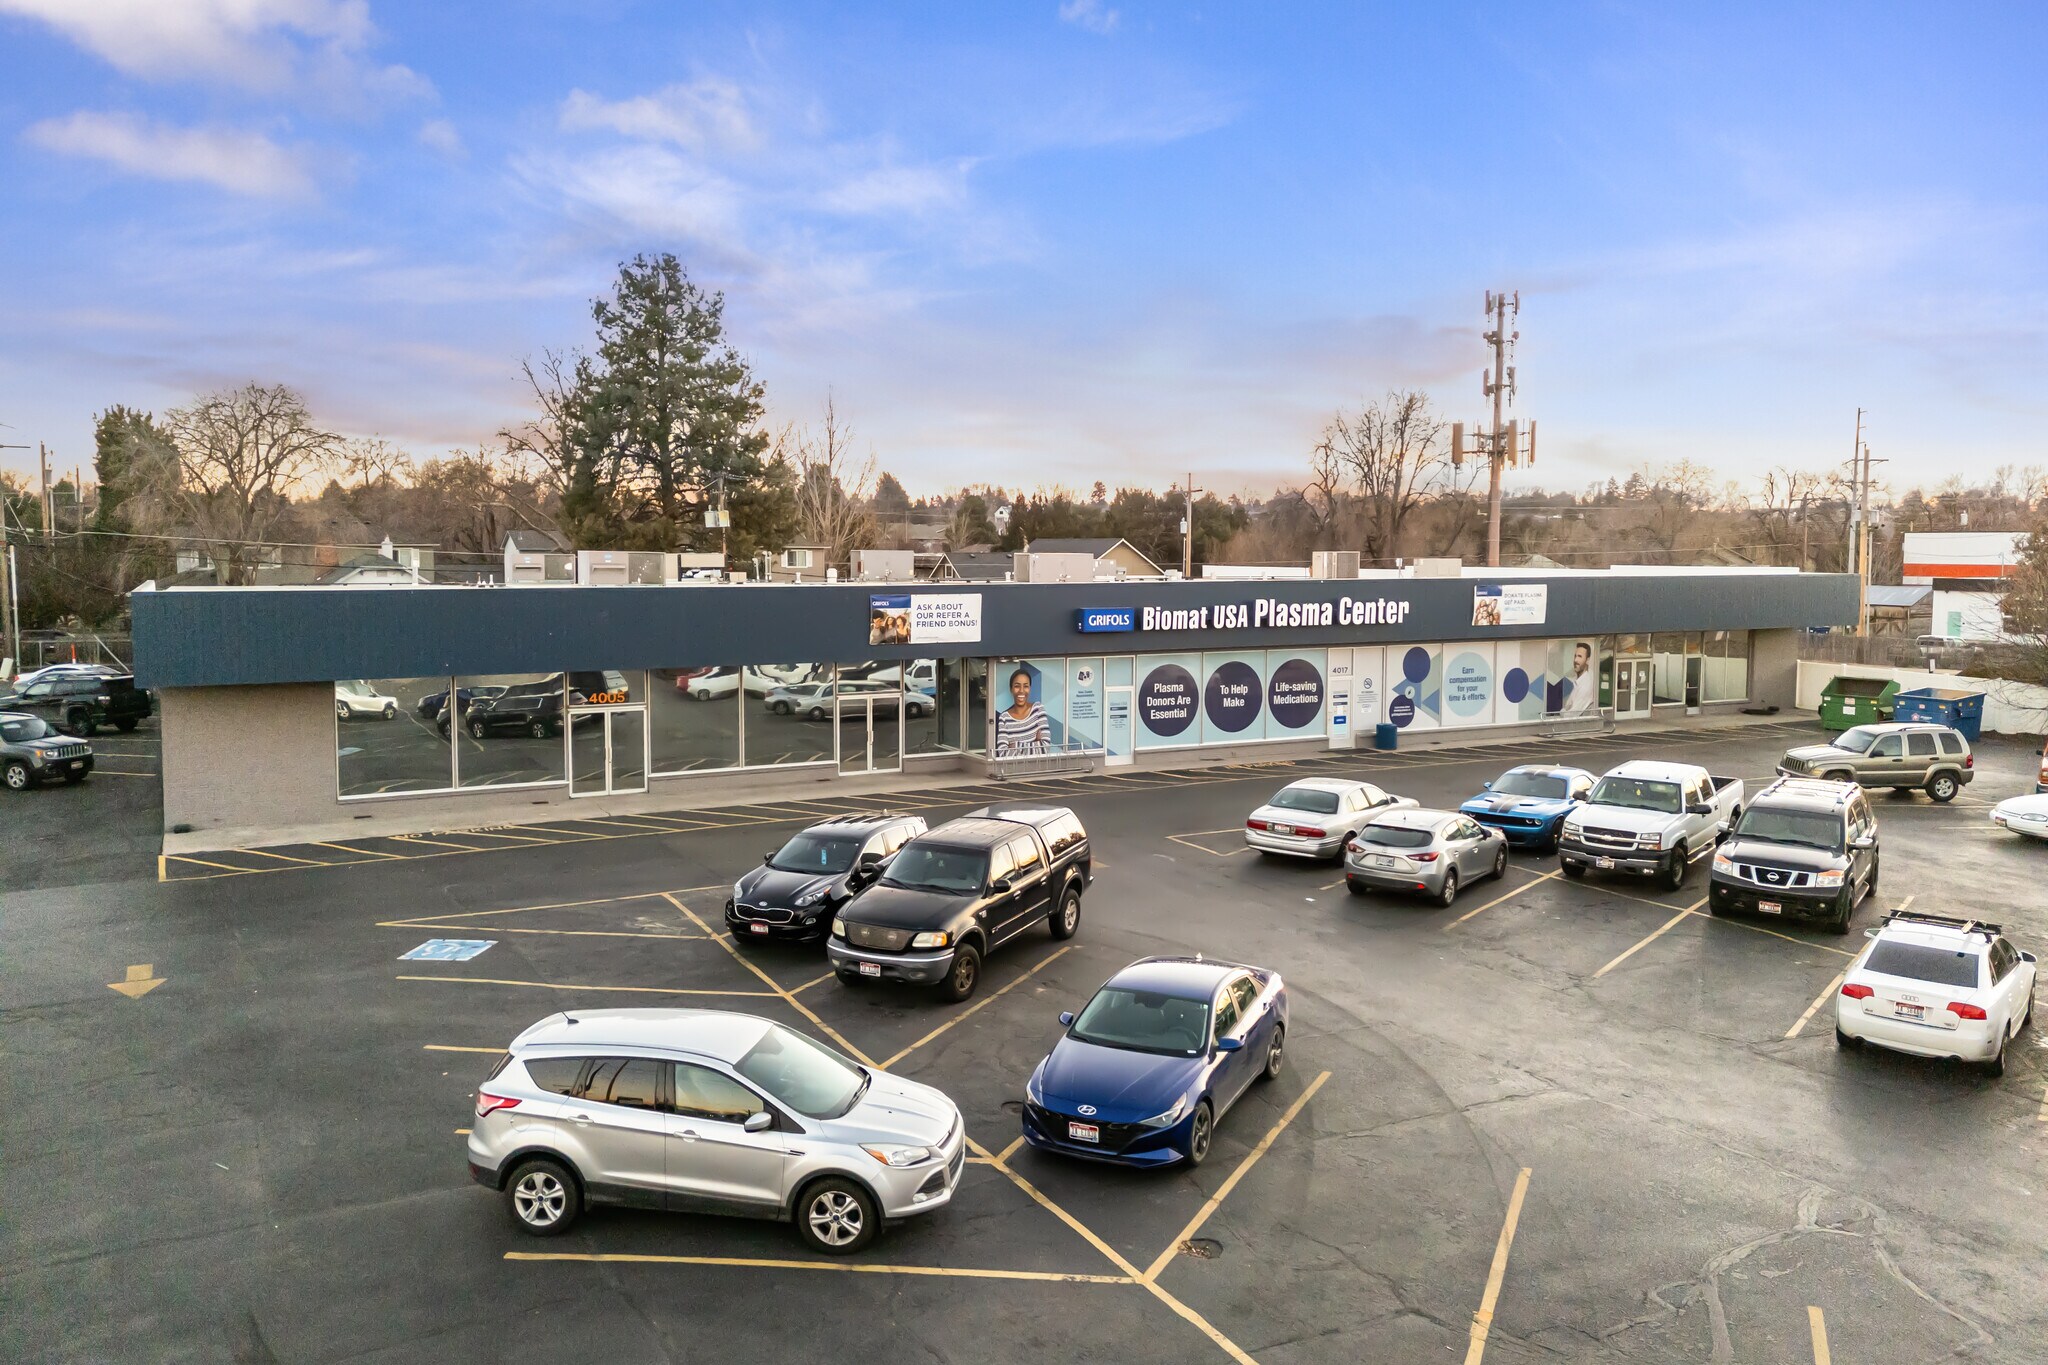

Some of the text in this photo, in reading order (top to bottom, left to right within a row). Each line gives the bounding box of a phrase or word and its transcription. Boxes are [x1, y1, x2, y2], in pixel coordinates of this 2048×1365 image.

[935, 603, 963, 611] ABOUT
[1088, 596, 1410, 631] GRIFOLS Biomat USA Plasma Center
[916, 619, 978, 628] FRIEND BONUS!
[1449, 675, 1487, 684] compensation
[1154, 683, 1184, 693] Plasma
[1220, 683, 1248, 696] To Help
[1275, 682, 1317, 693] Life-saving
[1465, 685, 1478, 693] your
[589, 691, 625, 703] 4005
[1146, 696, 1191, 707] Donors Are
[1223, 697, 1245, 708] Make
[1273, 694, 1319, 705] Medications
[1448, 694, 1461, 702] time
[1467, 693, 1487, 701] efforts.
[1150, 707, 1187, 720] Essential
